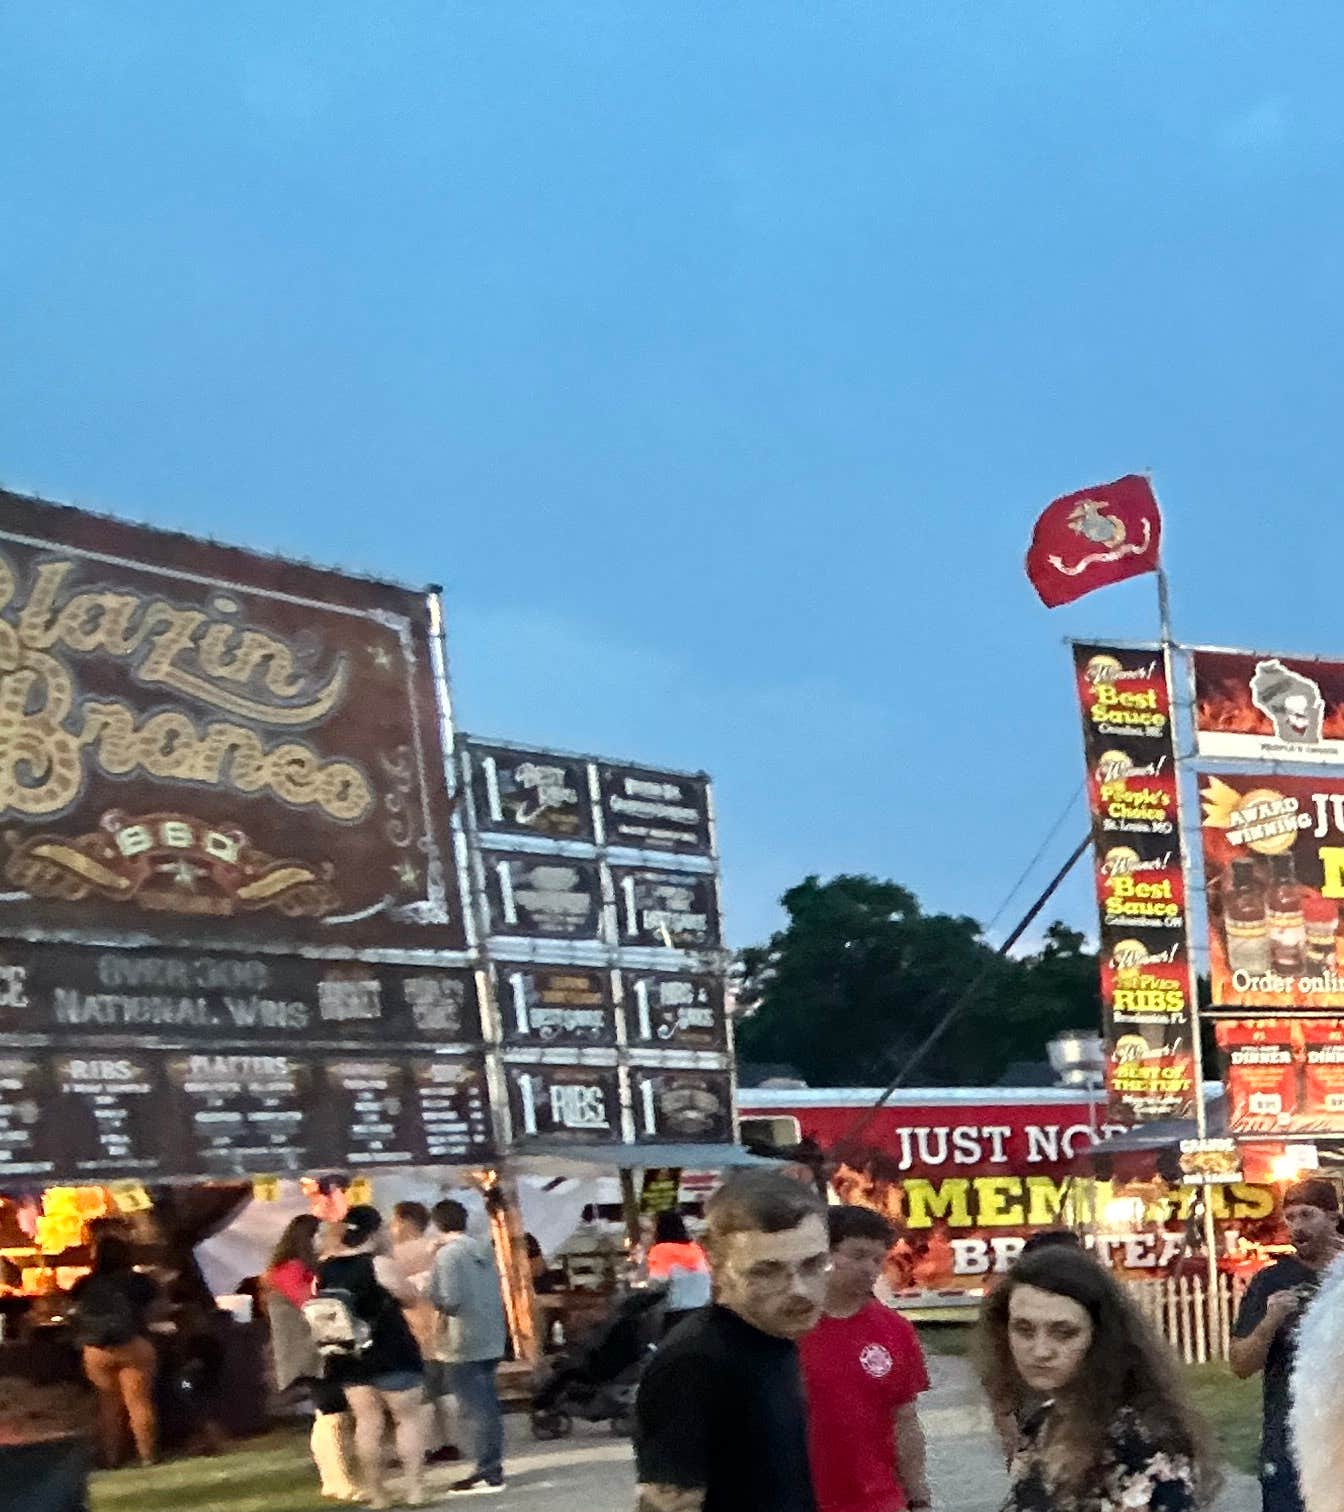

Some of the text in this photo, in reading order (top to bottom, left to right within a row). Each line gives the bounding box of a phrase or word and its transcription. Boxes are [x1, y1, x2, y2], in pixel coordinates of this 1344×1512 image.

[0, 558, 348, 723] lazin
[1097, 681, 1157, 711] Best
[1230, 797, 1298, 827] AWARD
[1226, 812, 1312, 846] WINNING
[1110, 873, 1172, 899] Best
[1232, 968, 1293, 993] Order
[1113, 989, 1184, 1012] RIBS
[896, 1126, 1011, 1170] JUST
